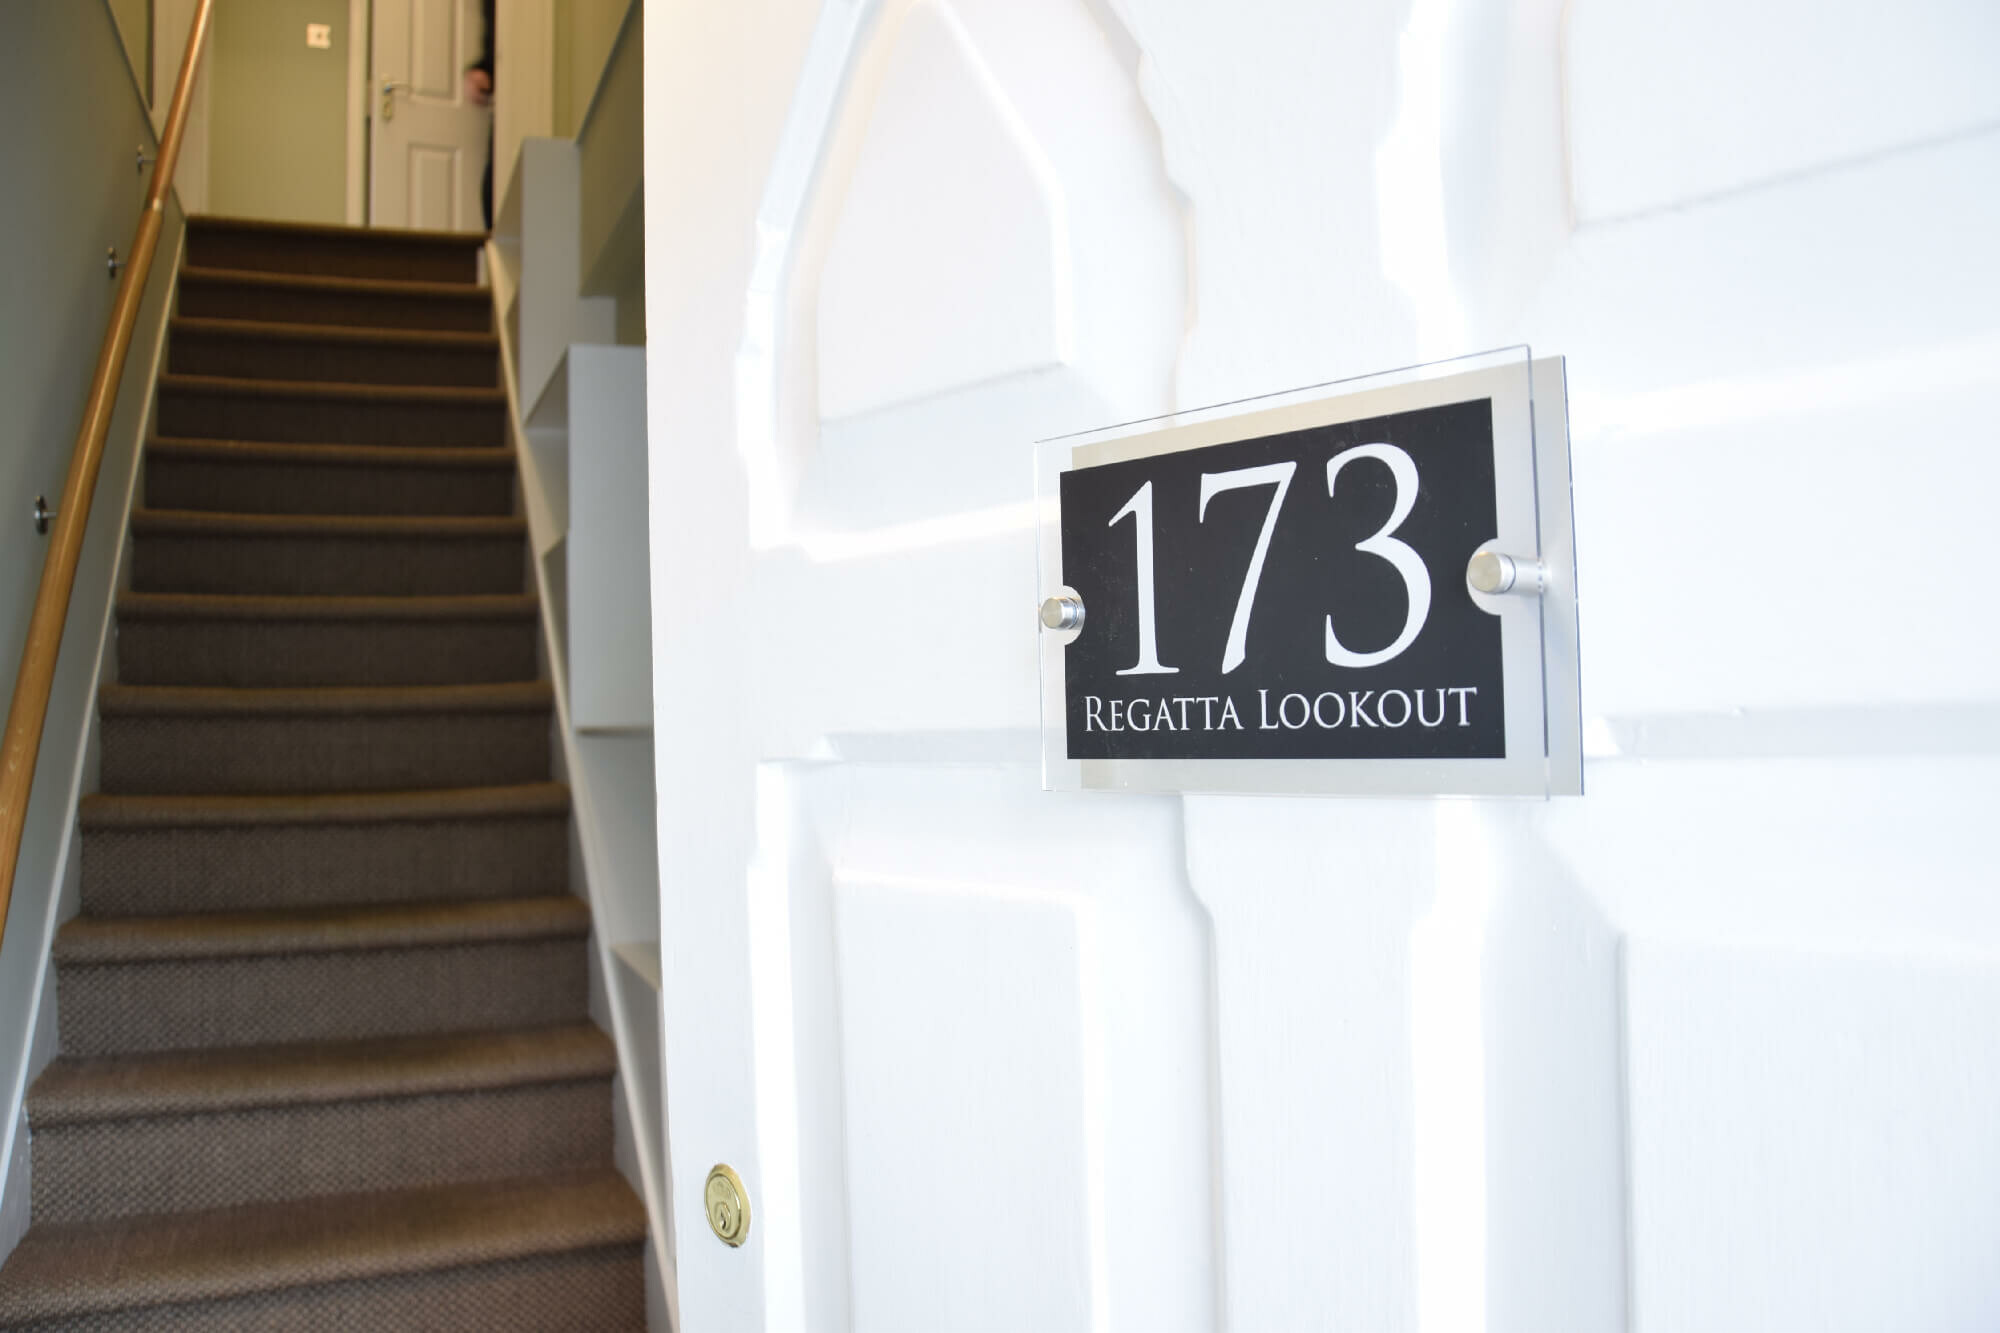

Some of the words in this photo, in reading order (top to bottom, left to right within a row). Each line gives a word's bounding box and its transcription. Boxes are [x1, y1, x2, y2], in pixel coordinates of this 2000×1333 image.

[1108, 442, 1432, 676] 173
[1084, 695, 1245, 732] REGATTA
[1257, 686, 1478, 731] LOOKOUT
